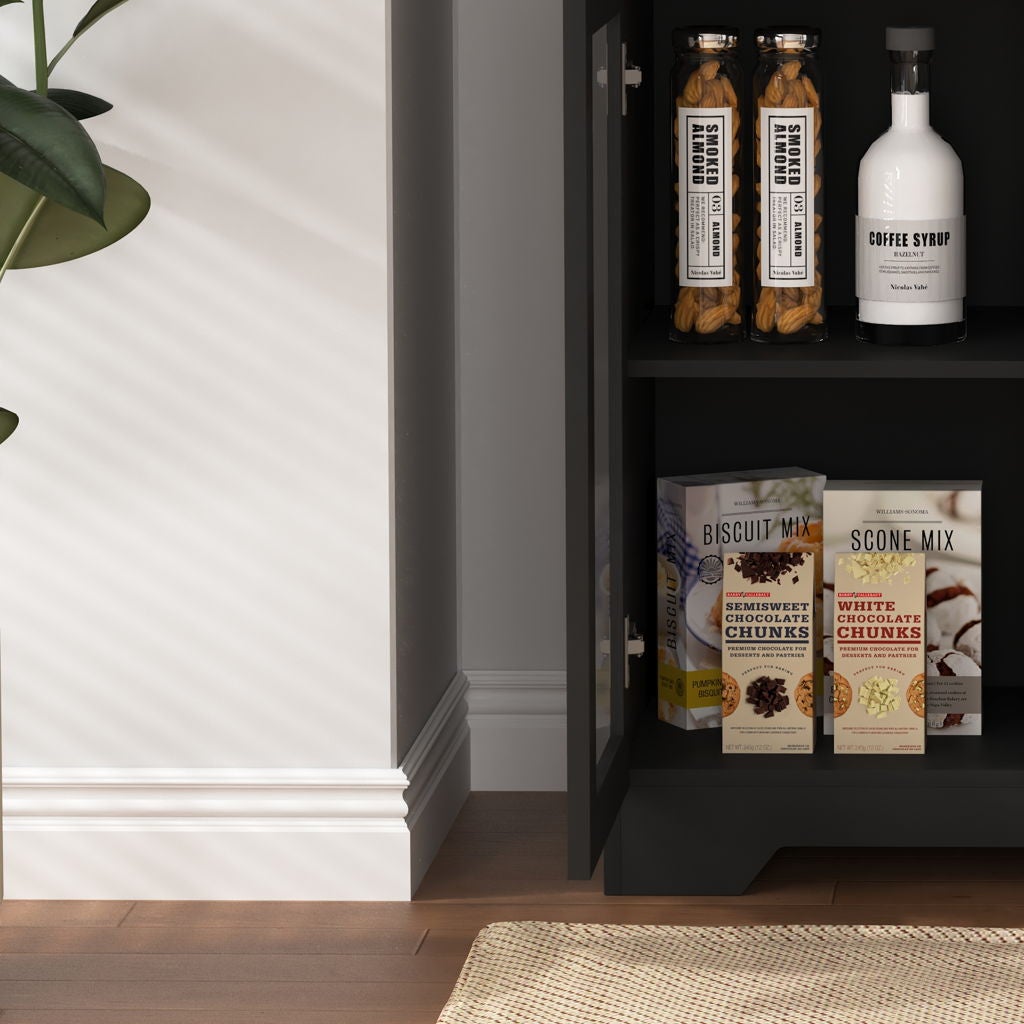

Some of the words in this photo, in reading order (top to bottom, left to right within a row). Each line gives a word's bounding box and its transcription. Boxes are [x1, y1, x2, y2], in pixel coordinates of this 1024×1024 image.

[692, 124, 704, 185] ALMOND
[706, 124, 719, 185] SMOKED
[774, 124, 786, 185] ALMOND
[788, 124, 801, 185] SMOKED
[712, 195, 721, 213] 03
[794, 195, 803, 213] 03
[712, 221, 720, 257] ALMOND
[794, 221, 802, 257] ALMOND
[869, 231, 908, 247] COFFEE
[913, 231, 950, 247] SYRUP
[704, 518, 772, 545] BISCUIT
[781, 515, 811, 539] MIX
[851, 529, 912, 551] SCONE
[921, 529, 954, 551] MIX
[666, 572, 677, 650] BISCUIT
[726, 602, 809, 611] SEMISWEET
[837, 601, 896, 612] WHITE
[725, 614, 809, 623] CHOCOLATE
[837, 614, 921, 623] CHOCOLATE
[725, 626, 809, 639] CHUNKS
[837, 626, 921, 639] CHUNKS
